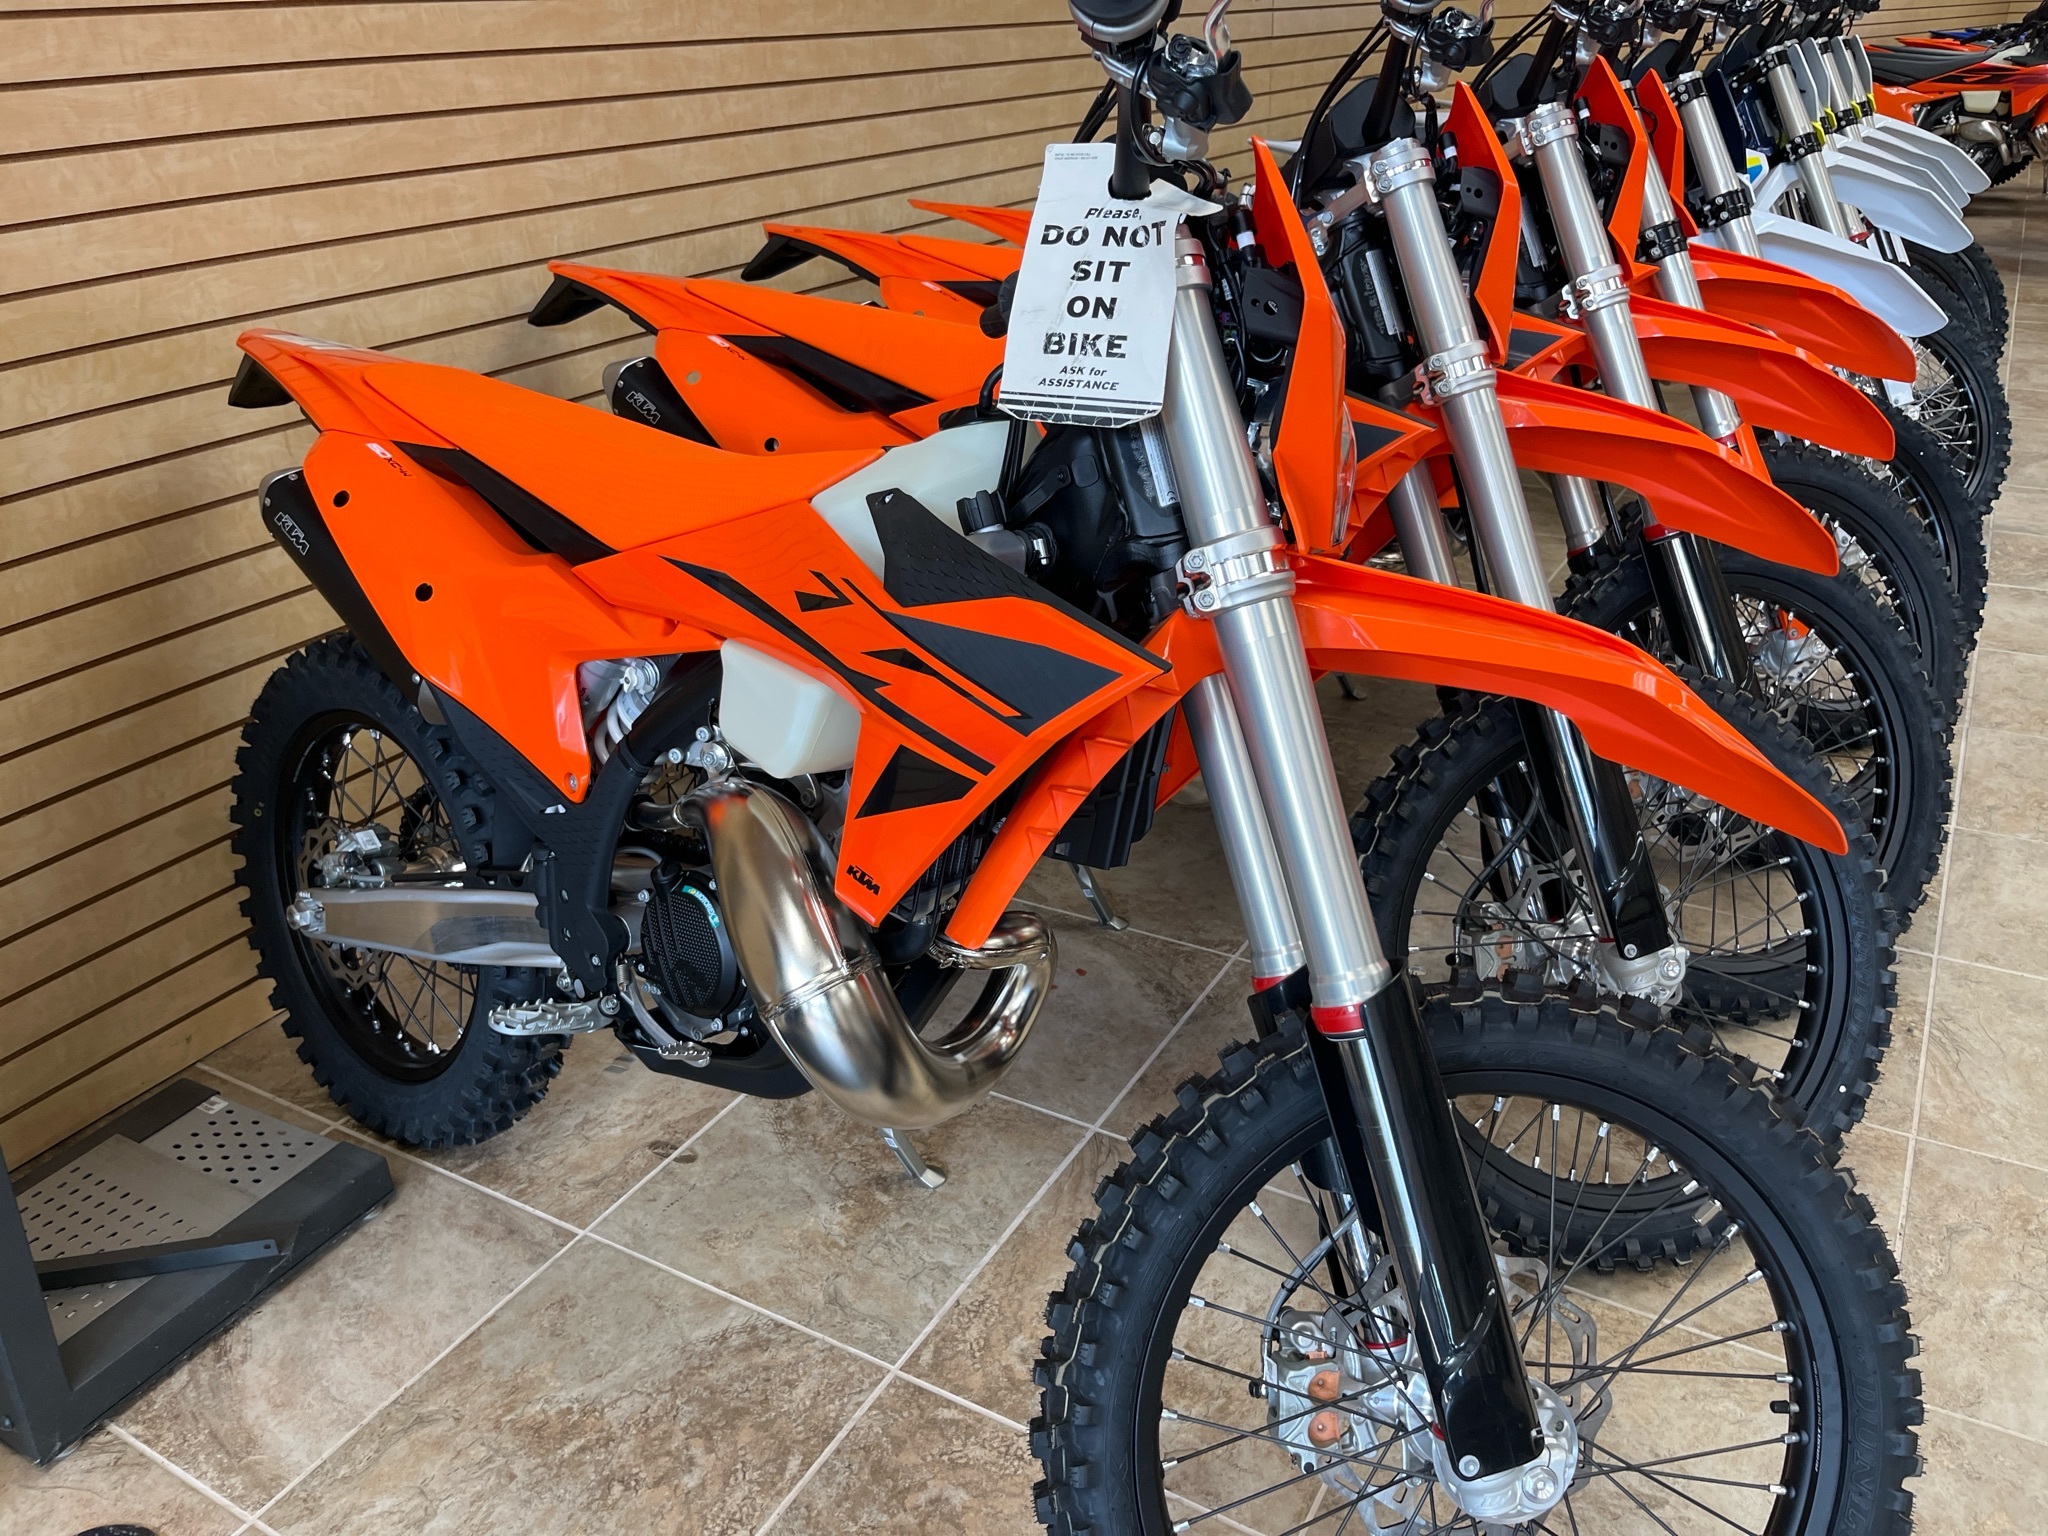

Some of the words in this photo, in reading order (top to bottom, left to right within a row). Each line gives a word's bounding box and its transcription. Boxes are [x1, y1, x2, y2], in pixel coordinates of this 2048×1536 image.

[1084, 207, 1142, 221] Please,
[1040, 224, 1090, 246] DO
[1102, 220, 1167, 248] NOT
[1070, 260, 1130, 283] SIT
[1066, 296, 1118, 320] ON
[1043, 332, 1128, 359] BIKE
[1038, 378, 1120, 391] ASSISTANCE
[1059, 366, 1085, 376] ASK
[1088, 367, 1108, 377] for
[626, 390, 661, 425] KTM
[274, 511, 310, 556] KTM
[846, 864, 881, 896] KTM
[693, 889, 717, 919] MOTOREX
[1848, 897, 1873, 1058] DUNLOP
[1843, 1371, 1882, 1536] DUNL
